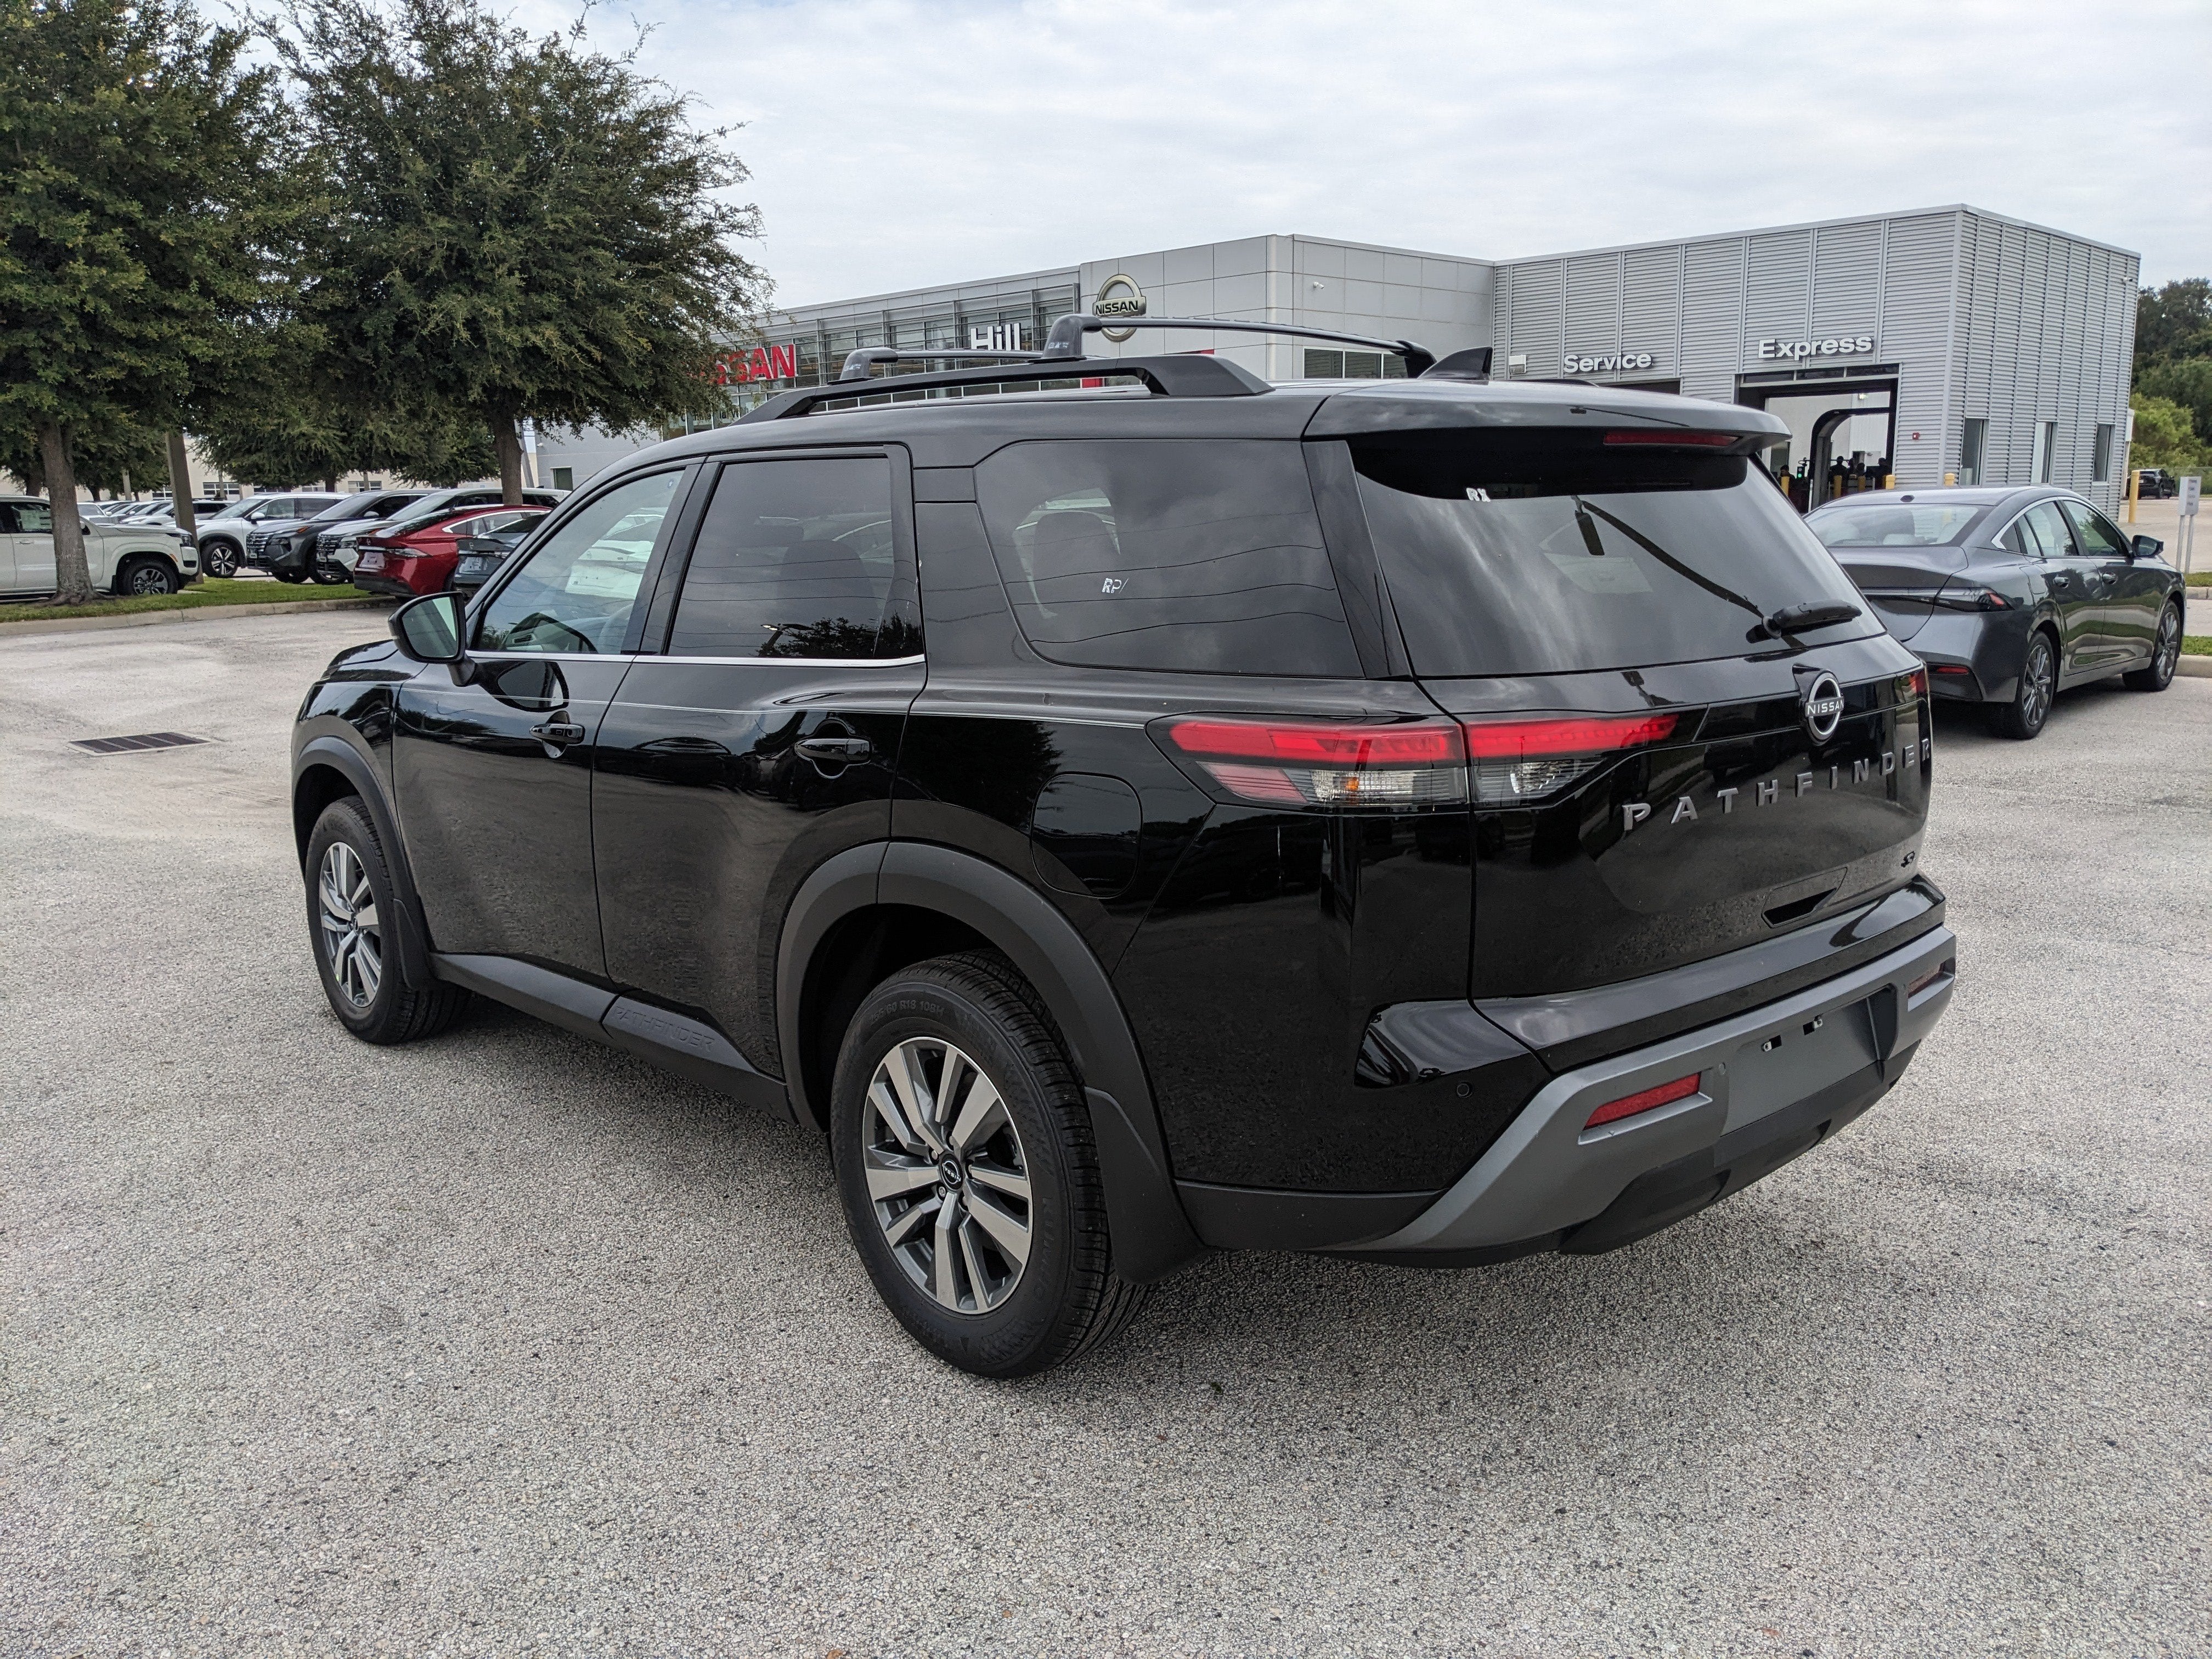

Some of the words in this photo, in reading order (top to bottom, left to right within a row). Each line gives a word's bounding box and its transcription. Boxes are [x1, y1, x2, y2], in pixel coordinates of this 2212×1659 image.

[1096, 300, 1139, 316] NISSAN
[970, 323, 1021, 351] Hill
[1759, 335, 1873, 362] Express
[1564, 352, 1652, 374] Service
[1807, 699, 1844, 715] NISSAN
[1622, 738, 1932, 831] PATHFINDER
